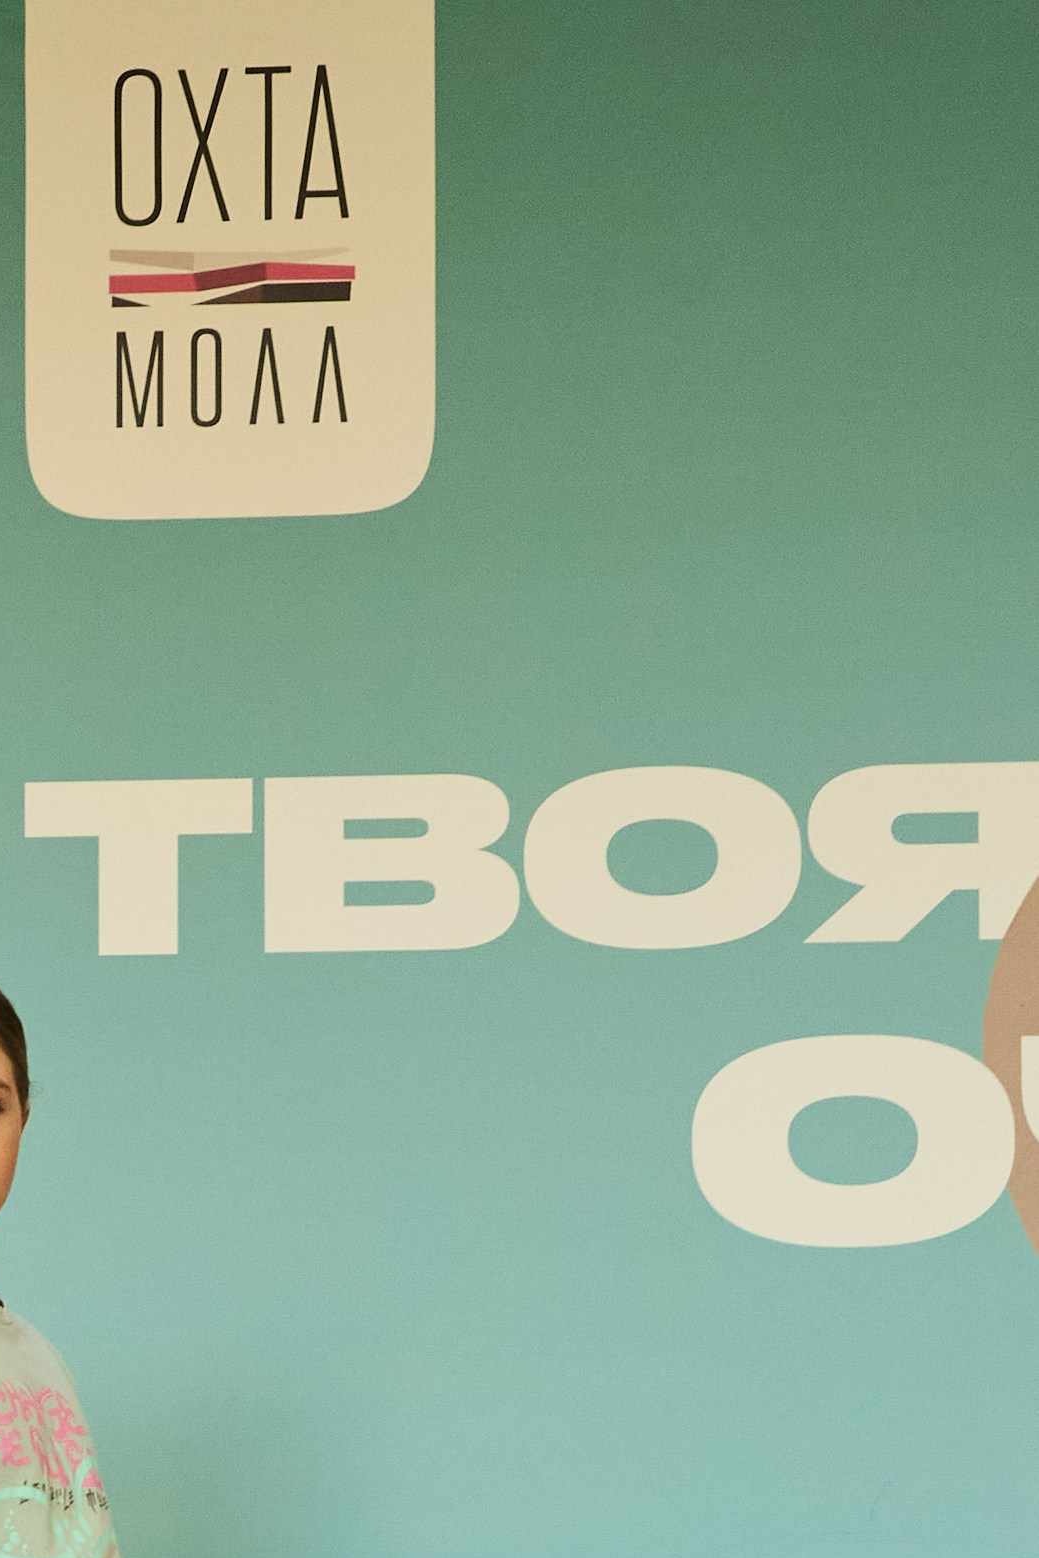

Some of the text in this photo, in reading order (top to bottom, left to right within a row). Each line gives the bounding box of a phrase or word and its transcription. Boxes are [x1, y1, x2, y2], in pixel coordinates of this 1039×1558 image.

[111, 64, 351, 227] ОХТА
[114, 325, 349, 428] МОЛЛ
[24, 760, 1039, 957] ТВОЯ
[691, 1034, 1039, 1248] О
